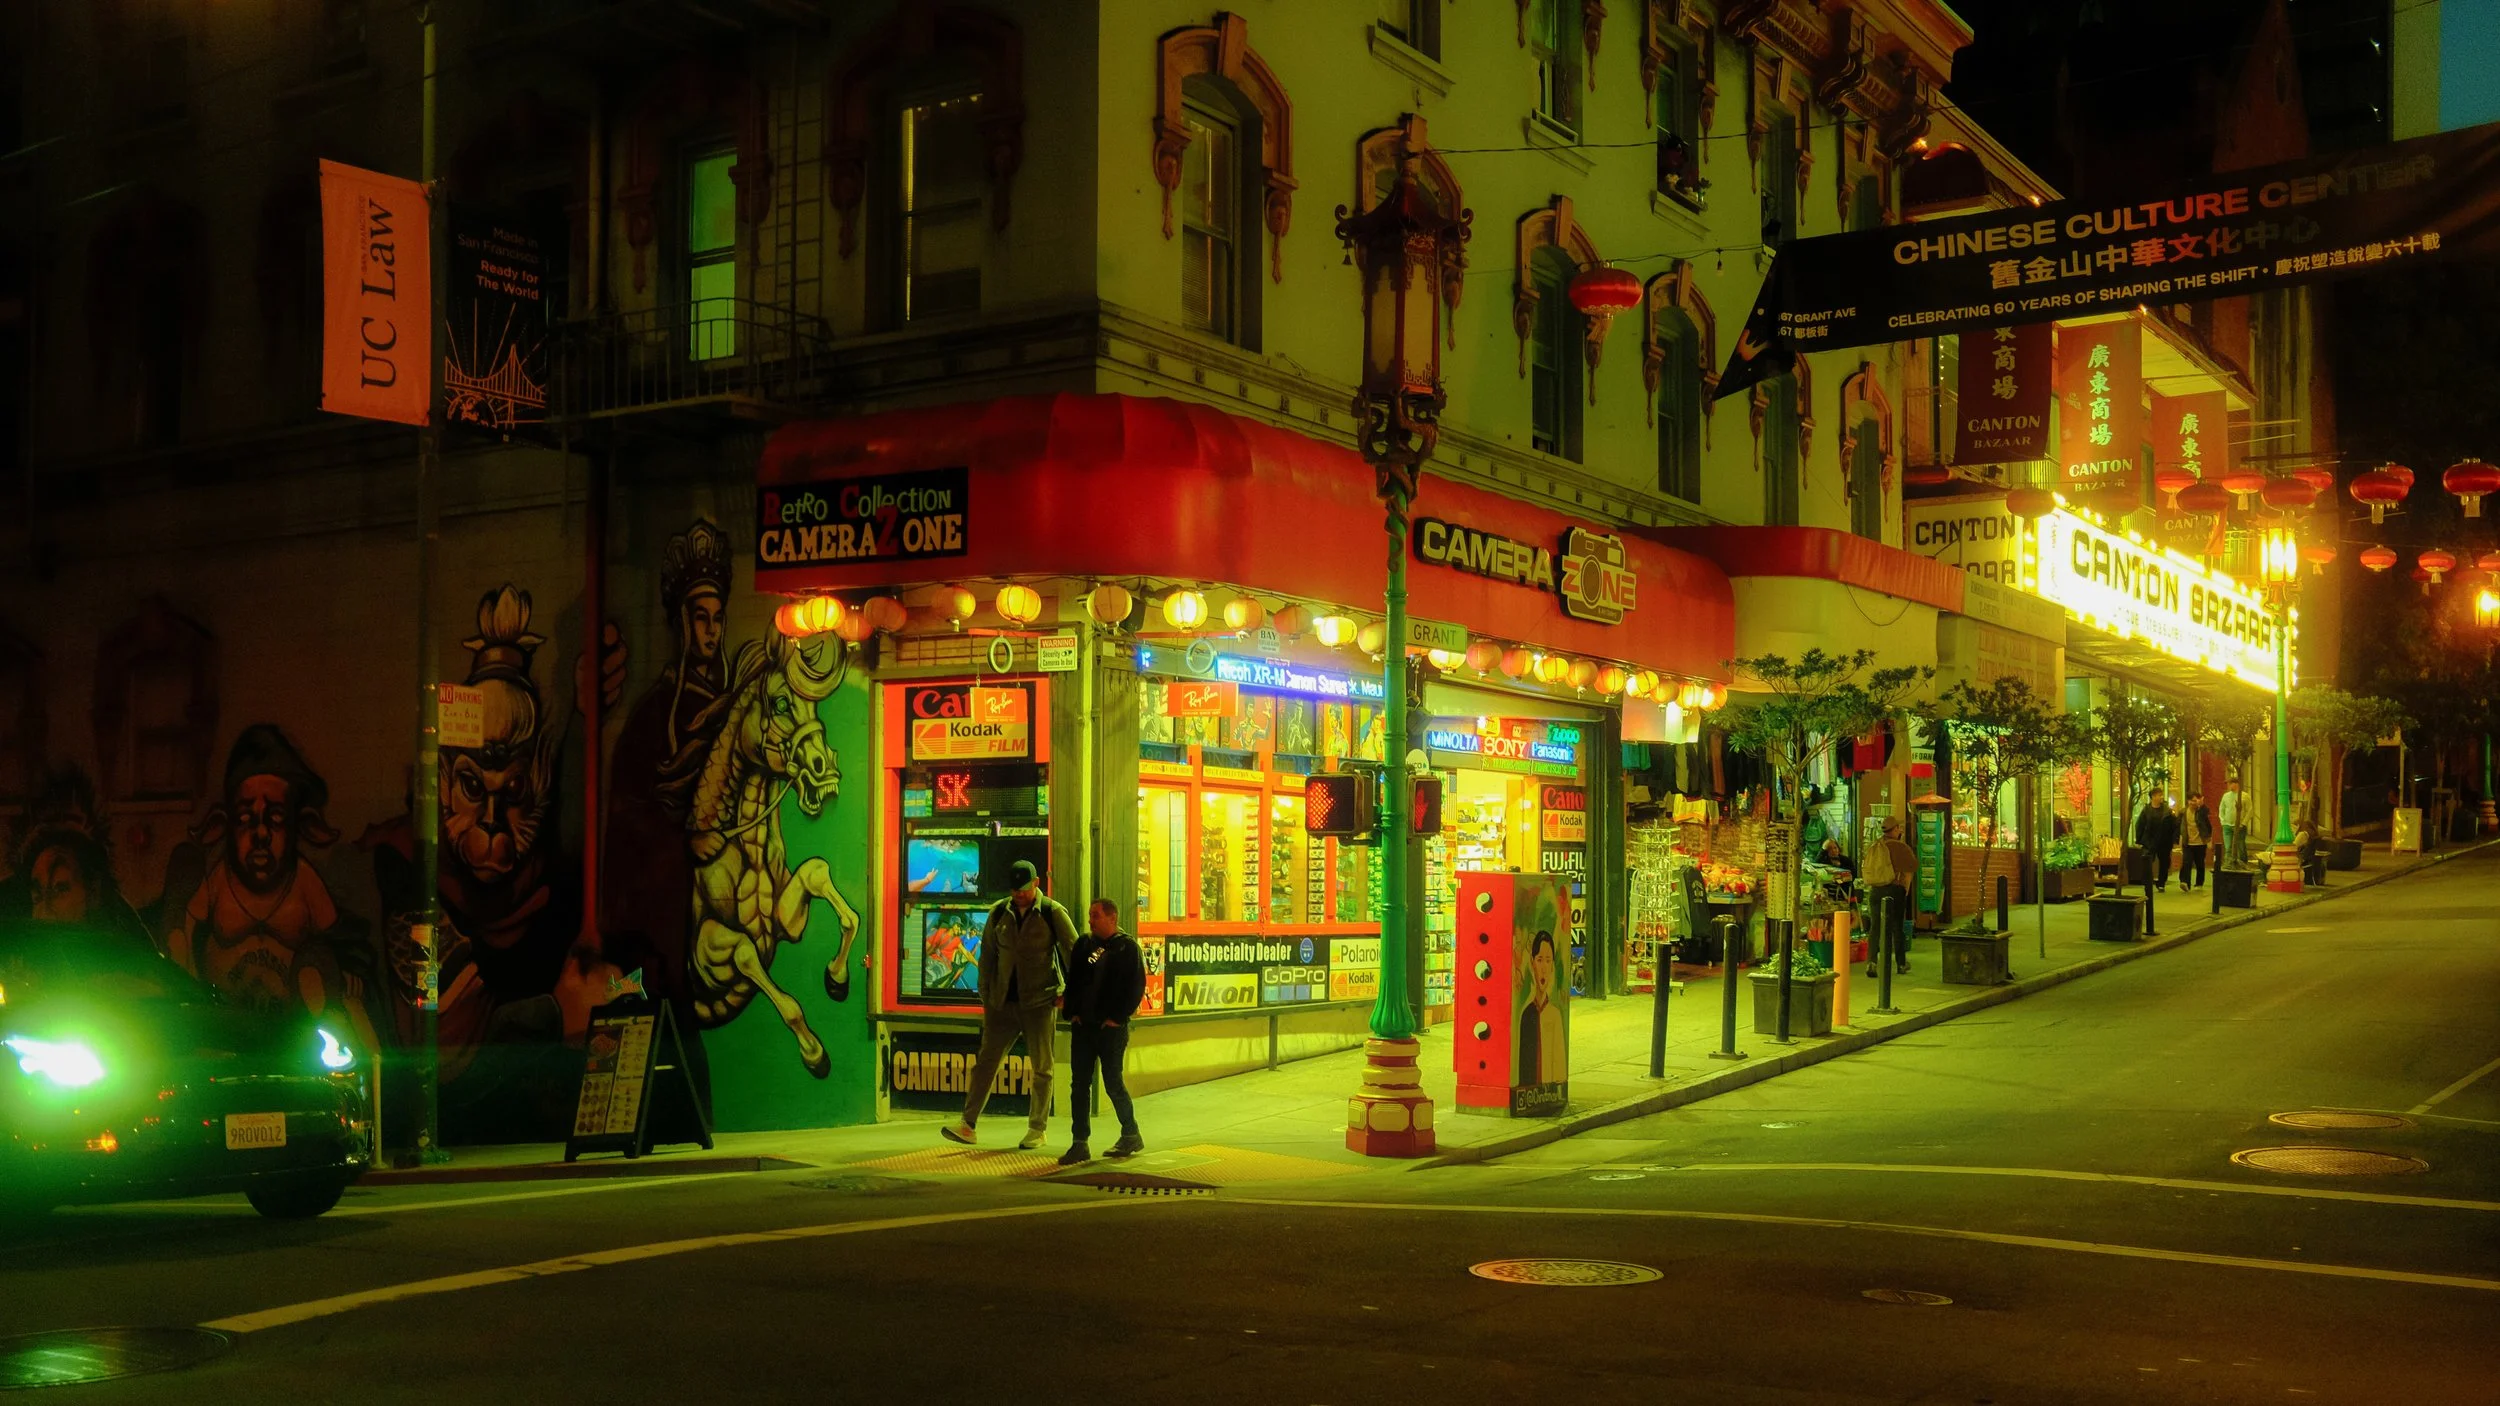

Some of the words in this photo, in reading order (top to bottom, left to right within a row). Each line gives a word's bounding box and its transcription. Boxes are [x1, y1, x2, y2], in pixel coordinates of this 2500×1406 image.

[1893, 219, 2057, 265] CHINESE
[2065, 186, 2251, 239] CULTURE
[2258, 153, 2437, 208] CENTER
[361, 197, 396, 302] Law
[457, 232, 480, 250] San
[492, 226, 526, 246] Made
[527, 237, 539, 251] in
[1988, 213, 2322, 291] 舊金山中華文化中心
[480, 259, 519, 281] Ready
[521, 270, 541, 285] for
[475, 273, 501, 291] The
[502, 280, 540, 301] World
[1888, 304, 1991, 329] CELEBRATING
[1994, 300, 2016, 316] 60
[2019, 292, 2072, 312] YEARS
[2074, 290, 2096, 305] OF
[2099, 279, 2171, 303] SHAPING
[2174, 273, 2207, 294] THE
[2210, 265, 2258, 286] SHIFT
[1778, 311, 1793, 322] 67
[1794, 310, 1833, 323] GRANT
[1834, 306, 1857, 319] AVE
[361, 316, 397, 389] UC
[2087, 344, 2114, 447] 廣東商場
[1968, 415, 2041, 434] CANTON
[1973, 435, 2032, 450] BAZAAR
[2068, 458, 2134, 478] CANTON
[760, 521, 878, 564] CAMERA
[875, 504, 963, 556] ZONE
[1915, 514, 2016, 546] CANTON
[1423, 520, 1555, 587] CAMERA
[1562, 555, 1637, 608] ZONE
[2070, 526, 2180, 615] CANTON
[2189, 582, 2274, 653] BAZAAR
[1042, 639, 1074, 648] WARNING
[1260, 630, 1276, 641] BAY
[1413, 623, 1458, 646] GRANT
[1042, 650, 1061, 659] Security
[441, 686, 453, 703] NO
[455, 691, 482, 705] PARKING
[986, 691, 1014, 715] Ray-Ban
[1183, 685, 1219, 708] Ray-Ban
[950, 722, 1003, 738] Kodak
[988, 738, 1026, 753] FILM
[1484, 736, 1528, 758] SONY
[937, 774, 970, 807] SK
[1543, 787, 1585, 811] Cano
[1560, 814, 1583, 826] Kodak
[1256, 942, 1292, 962] Dealer
[1340, 944, 1381, 964] Polaroi
[1264, 967, 1326, 985] GoPro
[1348, 972, 1375, 985] Kodak
[1178, 980, 1255, 1006] Nikon
[990, 1054, 1033, 1096] EPA
